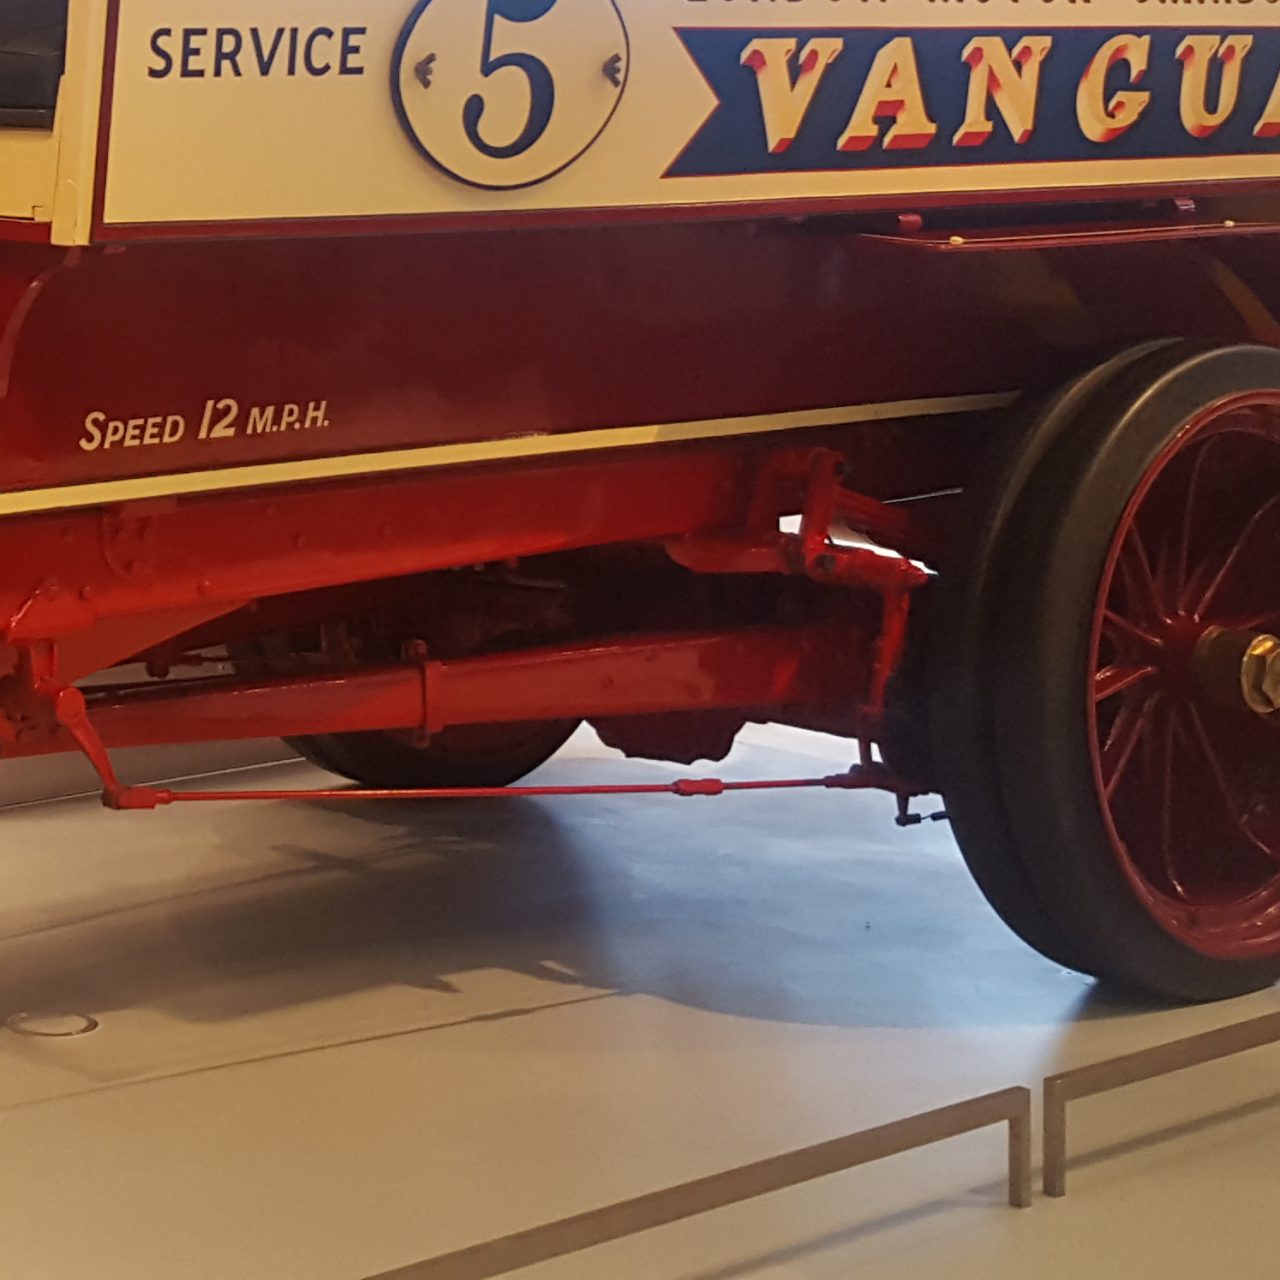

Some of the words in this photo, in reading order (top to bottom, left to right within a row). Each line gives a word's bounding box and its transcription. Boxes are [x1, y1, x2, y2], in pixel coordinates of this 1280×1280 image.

[147, 27, 367, 79] SERVICE
[197, 398, 239, 440] 12
[246, 400, 330, 435] M.P.H.
